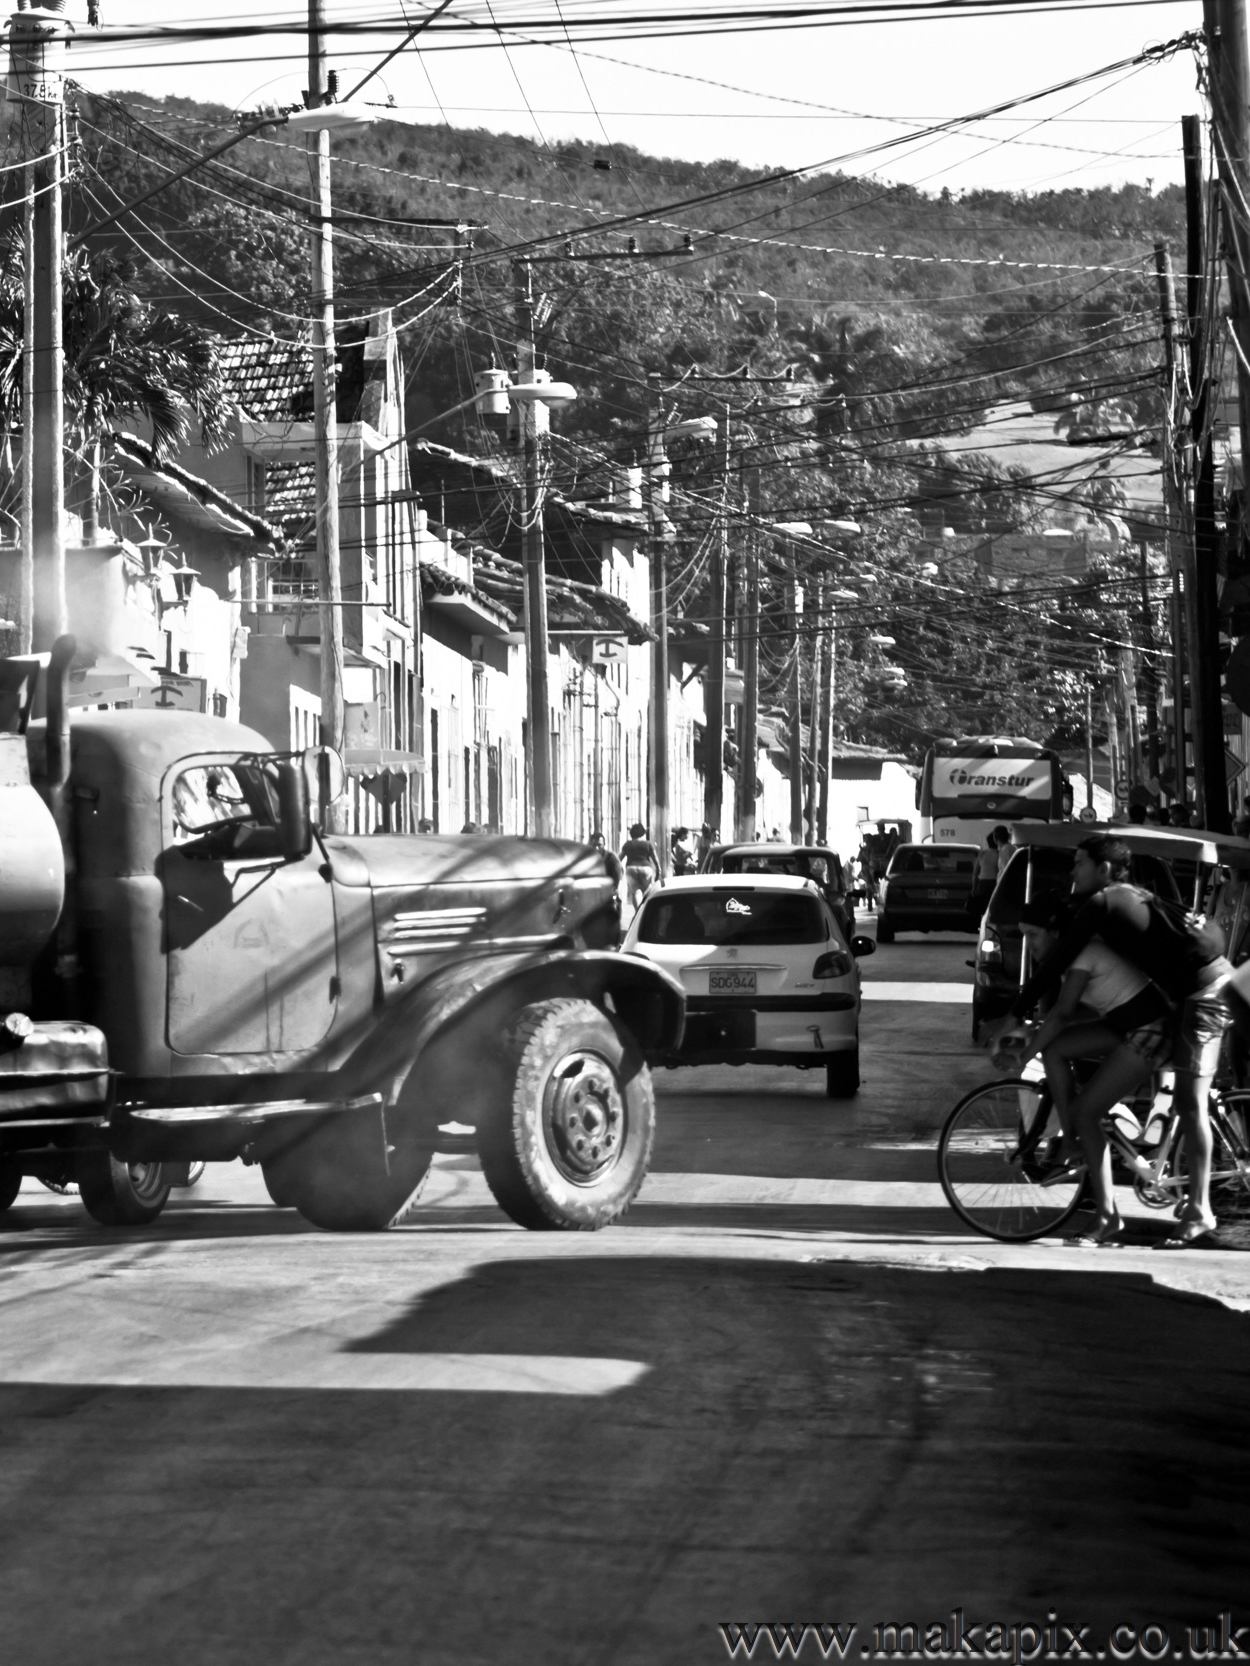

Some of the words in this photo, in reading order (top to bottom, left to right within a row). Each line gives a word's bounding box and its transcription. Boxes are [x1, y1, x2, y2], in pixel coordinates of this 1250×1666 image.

[949, 768, 1035, 787] Transtur
[940, 828, 956, 837] 578
[711, 976, 755, 989] SDG944
